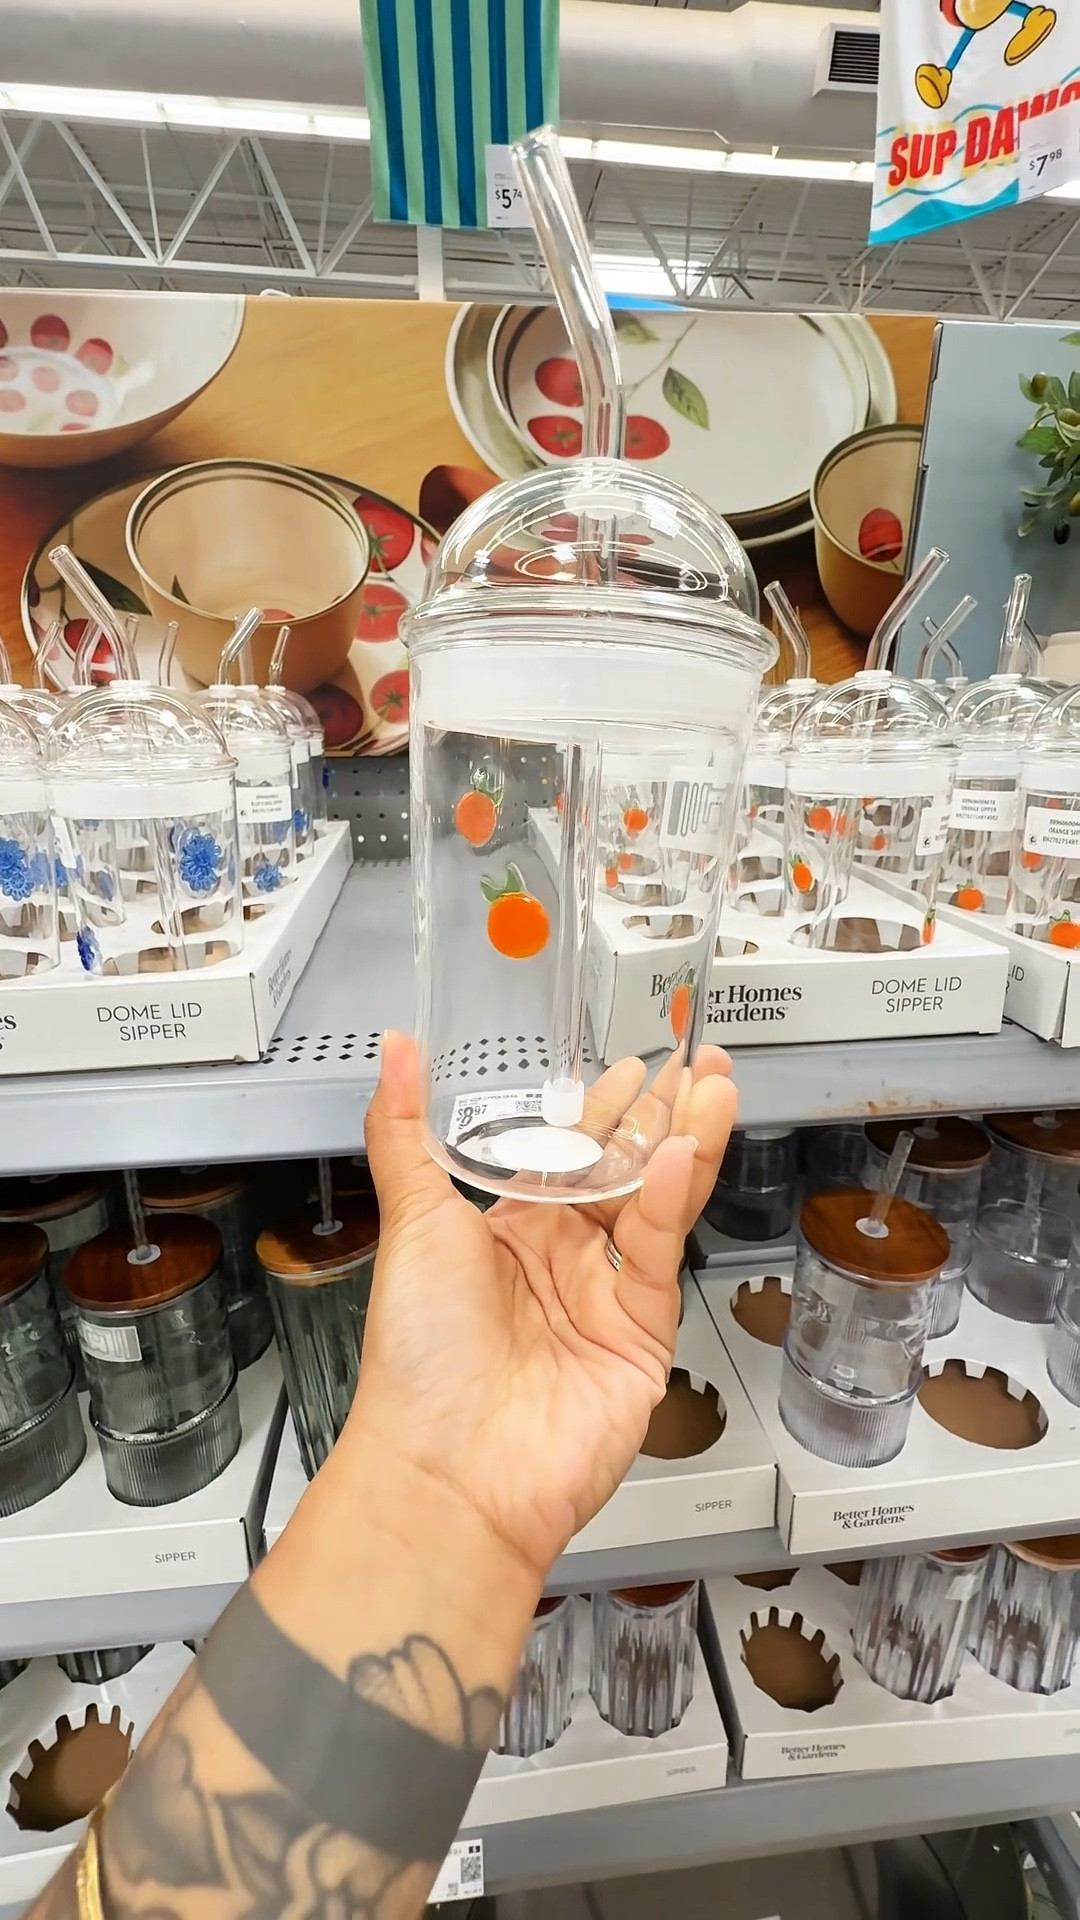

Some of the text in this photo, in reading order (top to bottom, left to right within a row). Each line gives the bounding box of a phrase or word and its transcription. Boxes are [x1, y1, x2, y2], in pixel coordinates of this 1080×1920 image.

[888, 81, 1080, 187] SUP DA
[1048, 827, 1069, 835] ORANGE
[728, 984, 803, 1004] Homes
[871, 976, 962, 995] DOME LID
[97, 1002, 202, 1022] DOME LID
[885, 996, 944, 1013] SIPPER
[119, 1023, 187, 1042] SIPPER
[695, 1499, 733, 1513] SIPPER
[833, 1504, 915, 1521] Better Homes
[841, 1515, 905, 1529] & Gardens
[154, 1551, 197, 1564] SIPPER
